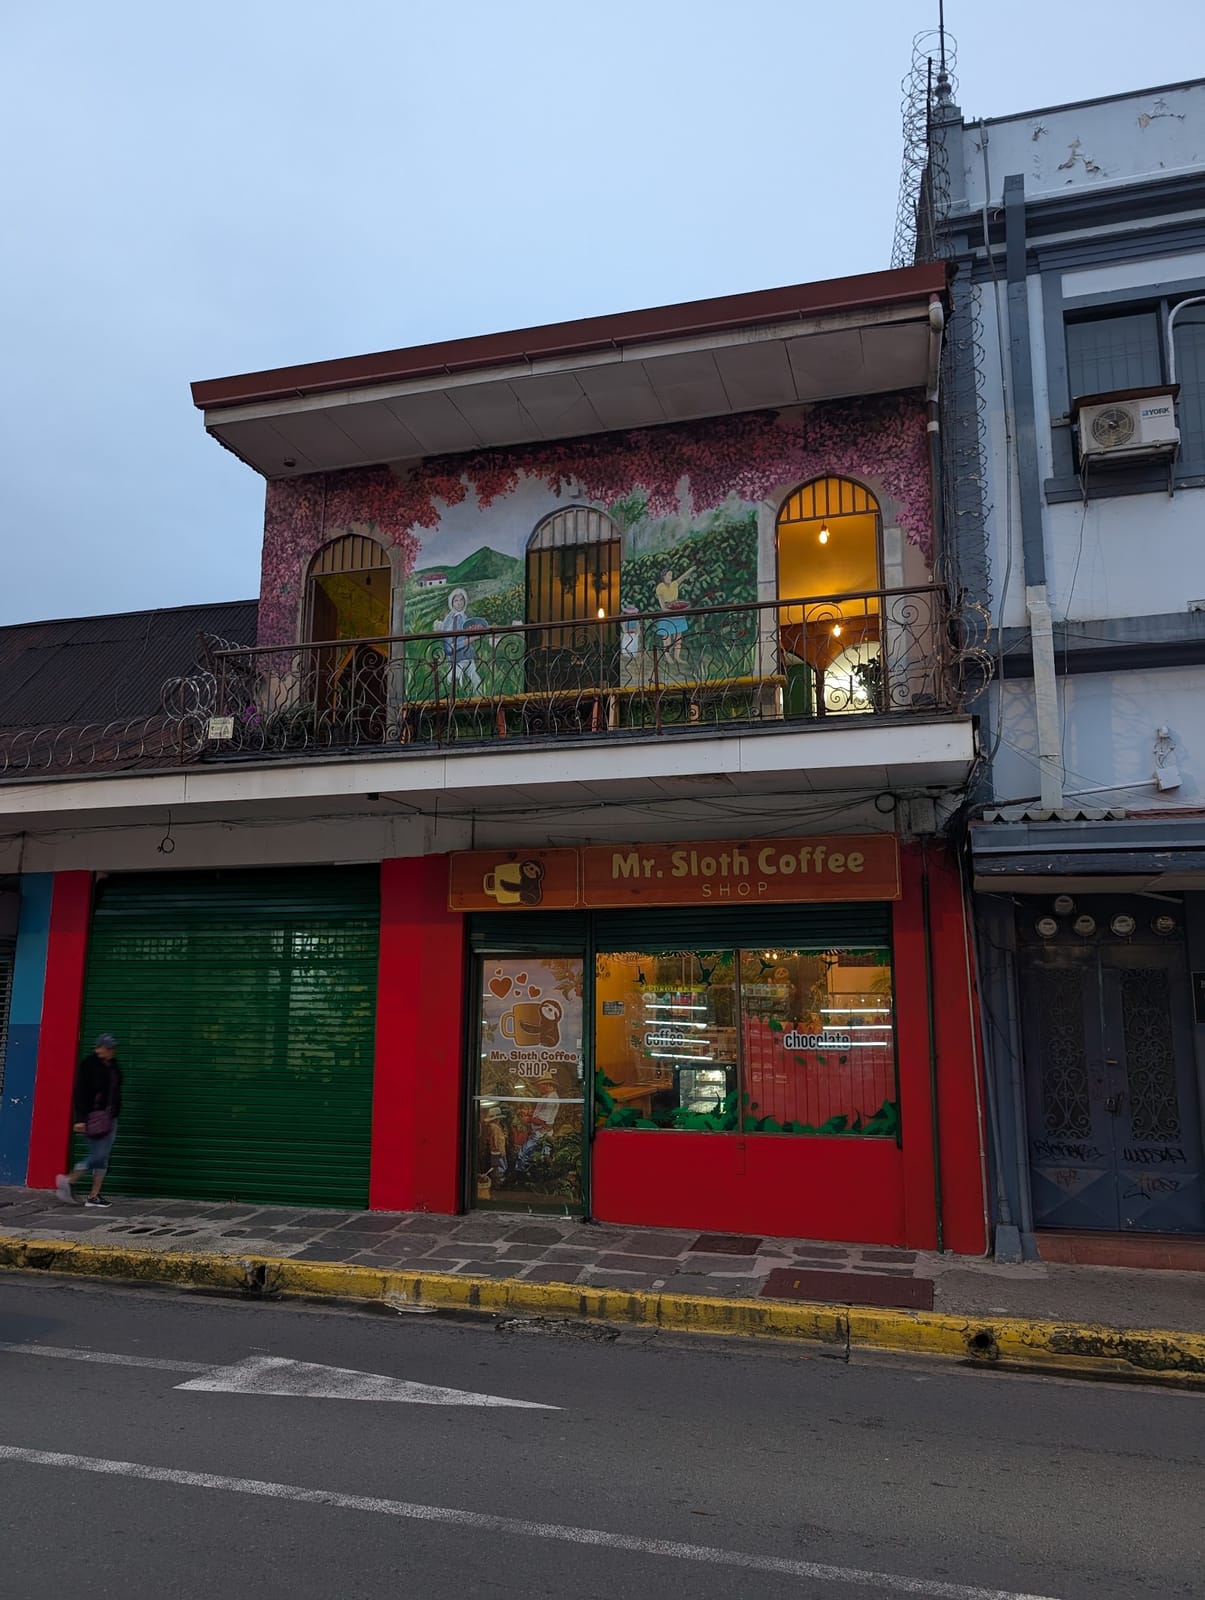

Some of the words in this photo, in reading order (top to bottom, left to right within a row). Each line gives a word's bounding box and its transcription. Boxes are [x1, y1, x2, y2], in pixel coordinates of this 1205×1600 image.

[1149, 407, 1170, 416] YORK
[612, 853, 663, 879] Mr.
[671, 849, 750, 877] Sloth
[758, 846, 865, 875] Coffee
[702, 882, 768, 898] SHOP
[646, 1029, 684, 1046] coffee
[785, 1031, 850, 1049] chocolate
[490, 1051, 507, 1061] Mr.
[510, 1051, 537, 1061] Sloth
[540, 1051, 576, 1061] Coffee
[519, 1062, 548, 1076] SHOP
